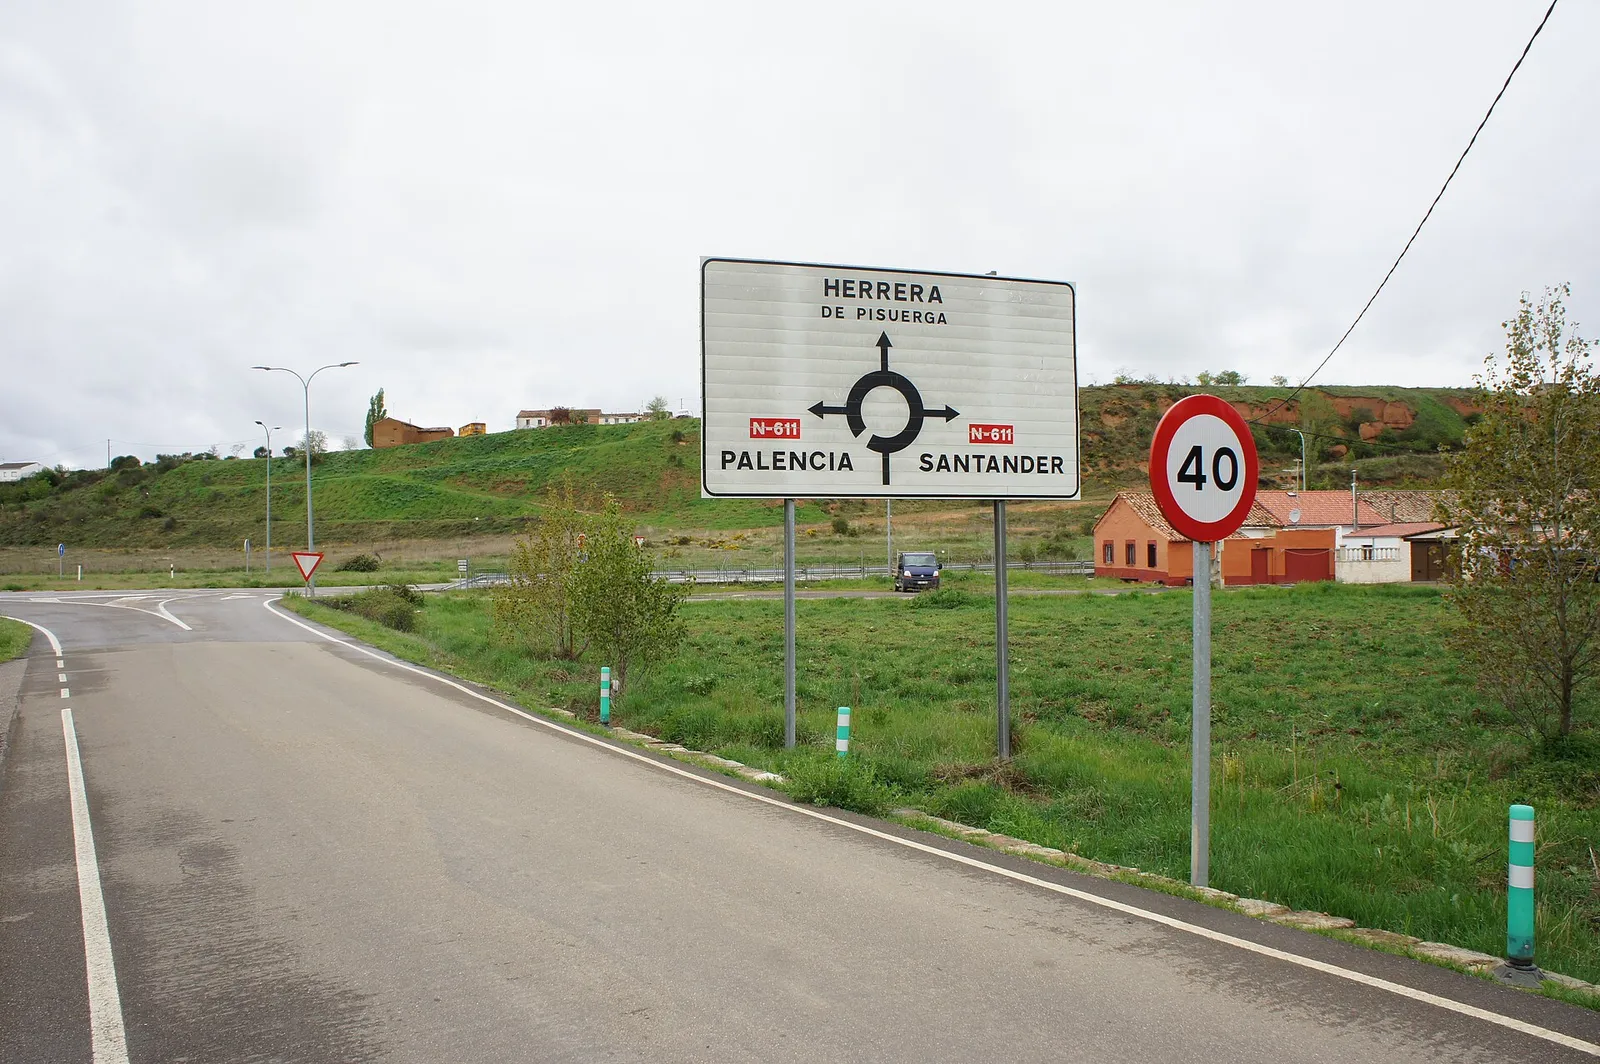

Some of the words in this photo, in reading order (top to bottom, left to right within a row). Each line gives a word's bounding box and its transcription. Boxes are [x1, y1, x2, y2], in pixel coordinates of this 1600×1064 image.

[823, 278, 943, 304] HERRERA
[821, 305, 845, 319] DE
[856, 307, 948, 325] PISUERGA
[752, 420, 798, 436] N-611
[970, 426, 1013, 441] N-611
[721, 450, 854, 472] PALENCIA
[919, 452, 1064, 475] SANTANDER
[1177, 445, 1238, 491] 40
